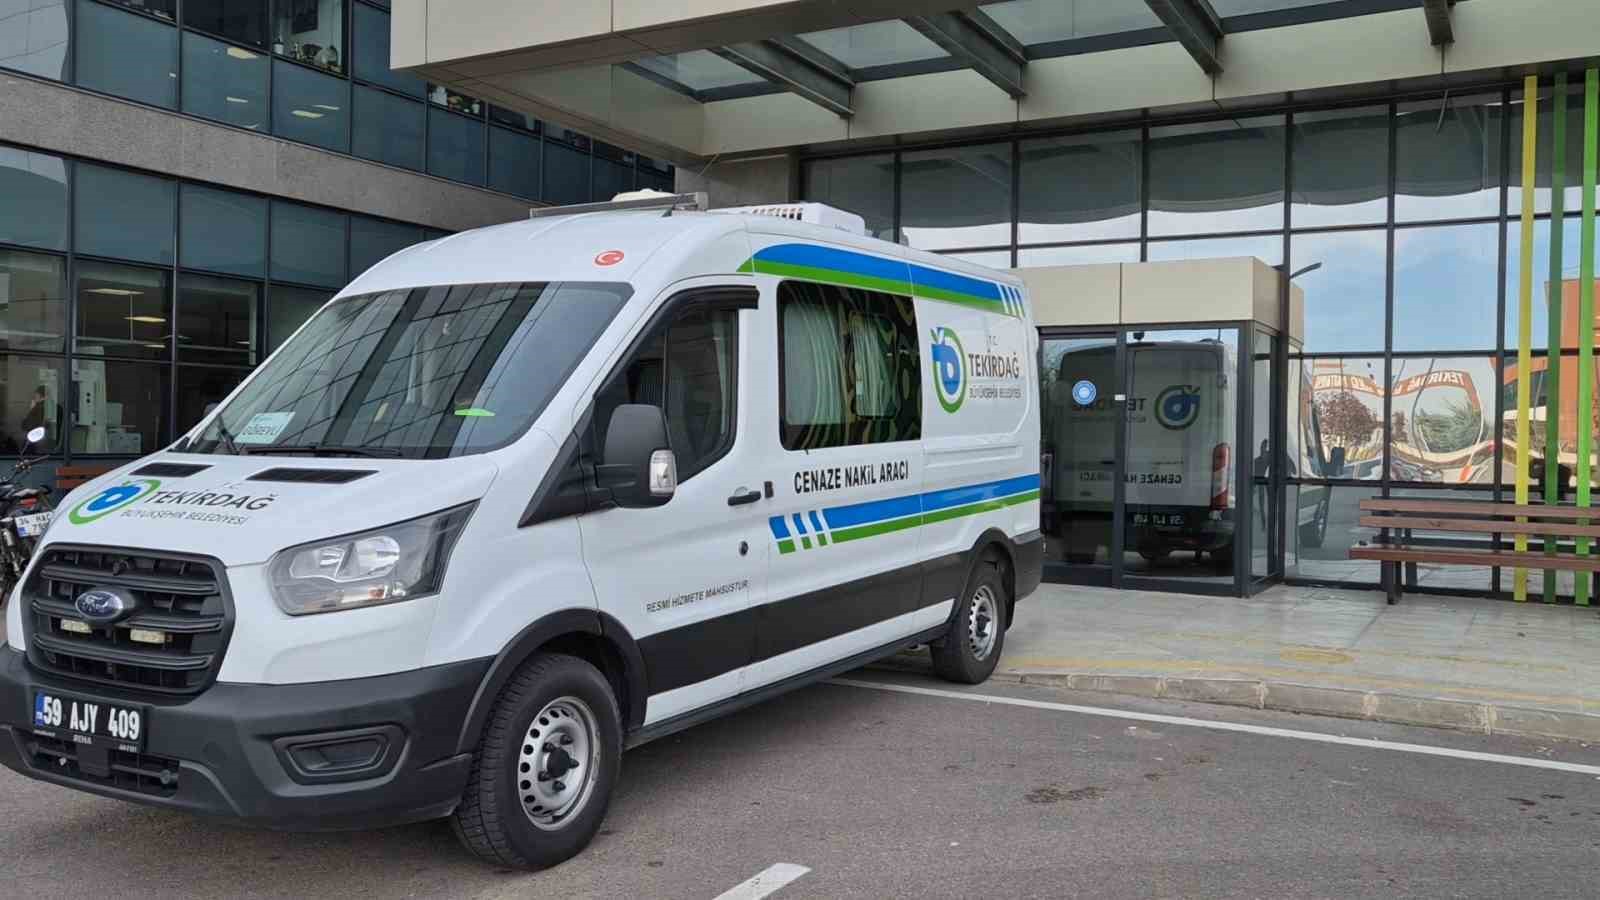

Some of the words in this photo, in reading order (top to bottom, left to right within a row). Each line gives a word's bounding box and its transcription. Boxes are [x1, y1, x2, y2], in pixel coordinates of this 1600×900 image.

[968, 348, 1019, 379] TEKİRDAĞ
[793, 467, 842, 494] CENAZE
[879, 460, 909, 484] ARACI
[144, 488, 279, 510] TEKİRDAĞ
[43, 696, 62, 726] 59
[69, 702, 98, 734] AJY
[108, 707, 140, 740] 409
